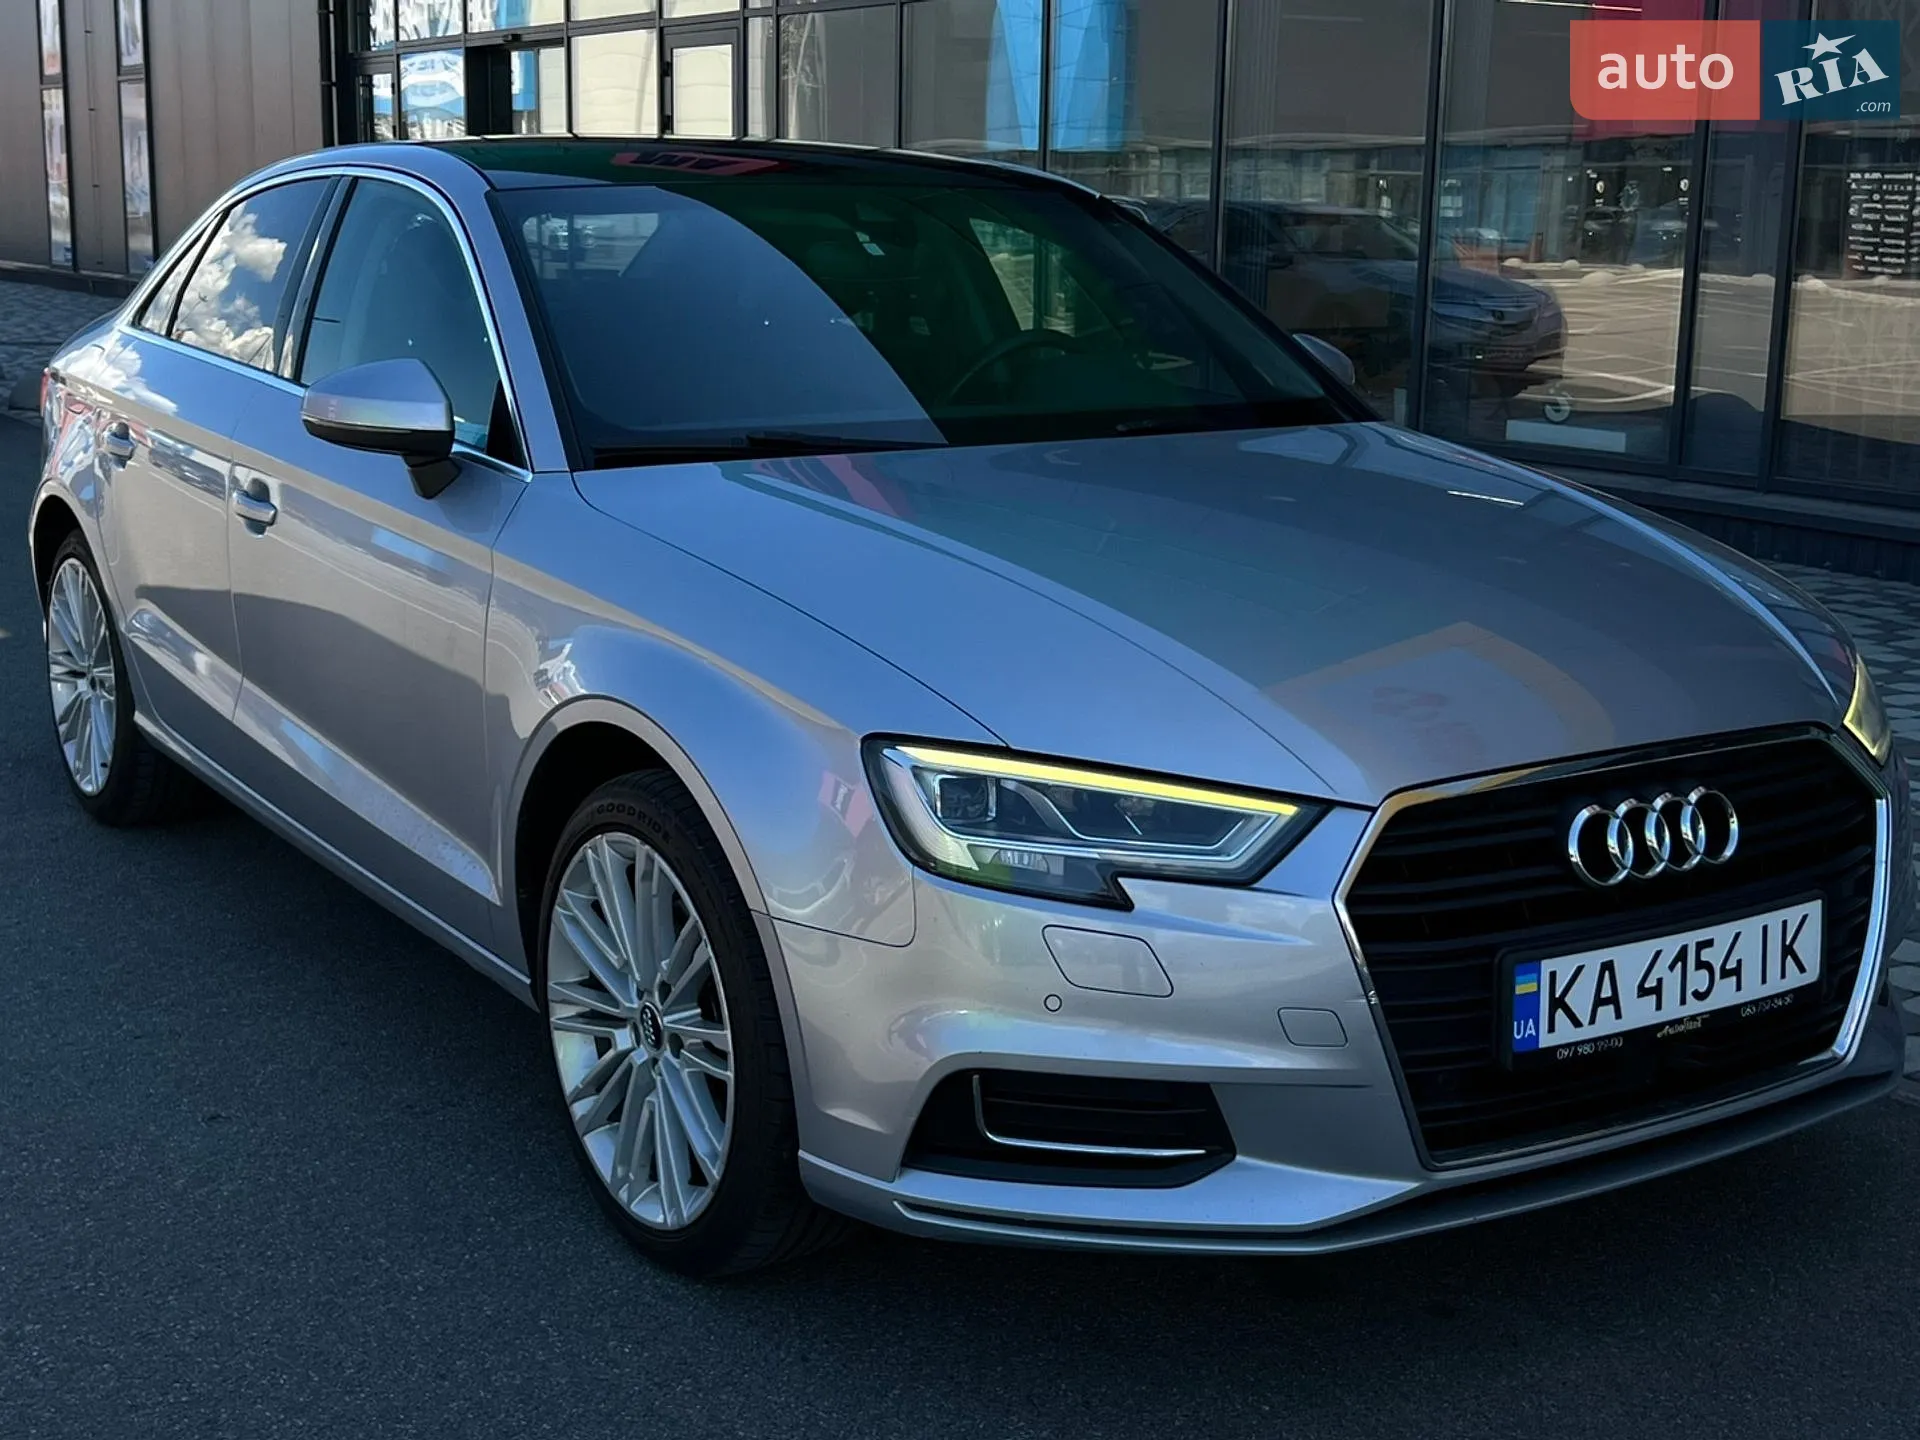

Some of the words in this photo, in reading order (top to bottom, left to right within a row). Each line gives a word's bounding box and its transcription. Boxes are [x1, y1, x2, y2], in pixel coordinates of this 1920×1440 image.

[597, 801, 672, 844] GOODRIDE
[1547, 959, 1623, 1035] KA
[1636, 931, 1743, 1012] 4154
[1760, 913, 1810, 986] IK
[1513, 1018, 1537, 1040] UA
